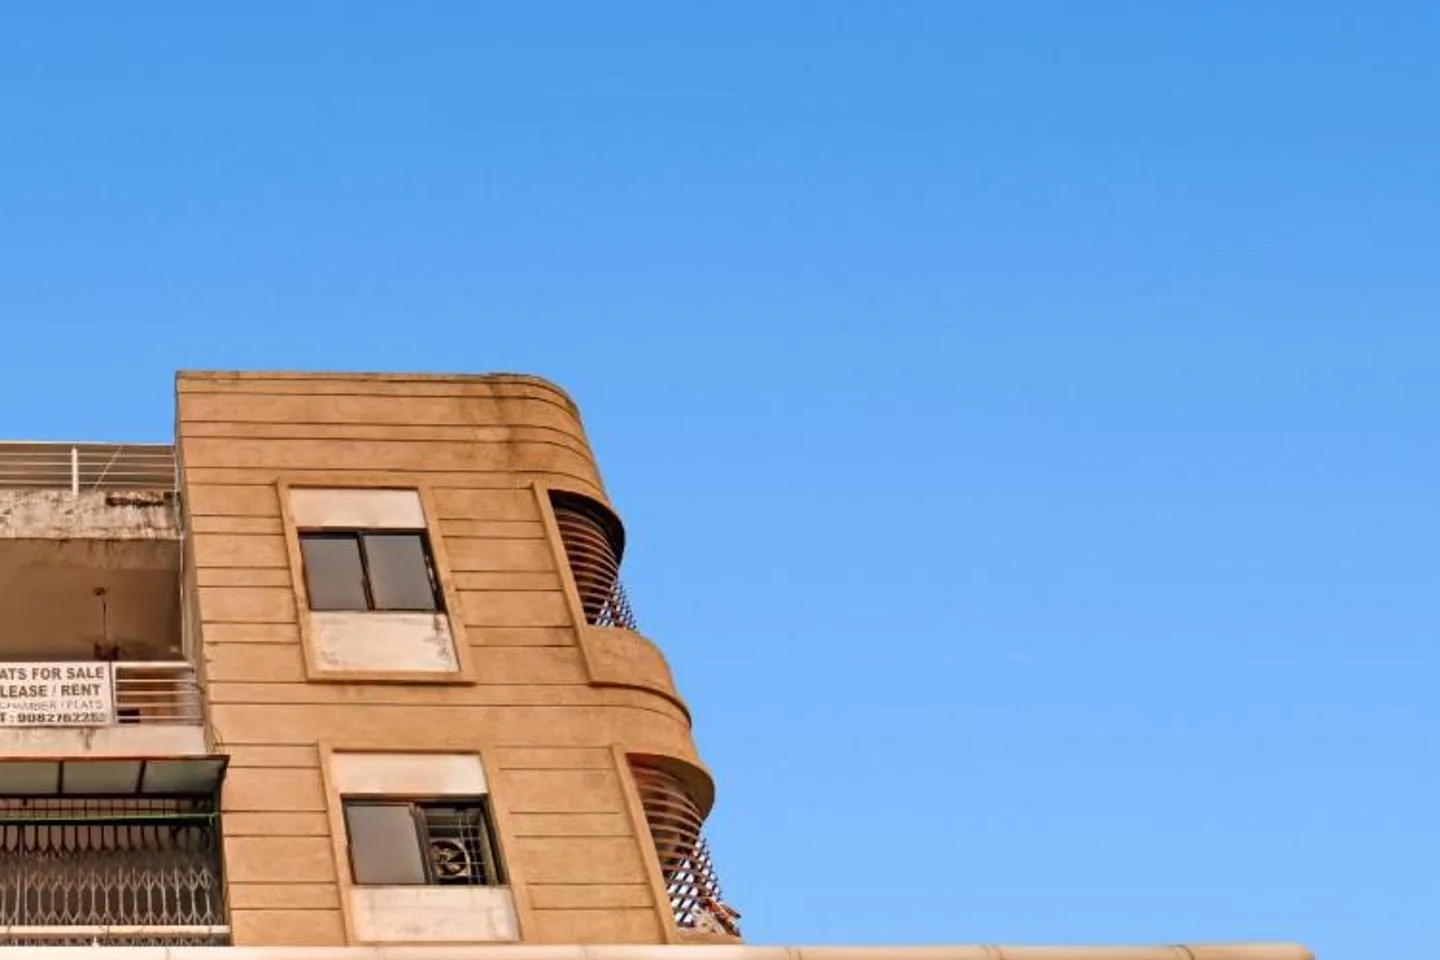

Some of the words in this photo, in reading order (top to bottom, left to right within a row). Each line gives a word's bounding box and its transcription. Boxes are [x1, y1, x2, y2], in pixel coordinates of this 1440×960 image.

[31, 667, 62, 680] FOR
[66, 666, 105, 680] SALE
[0, 685, 48, 698] LEASE
[60, 683, 101, 696] RENT
